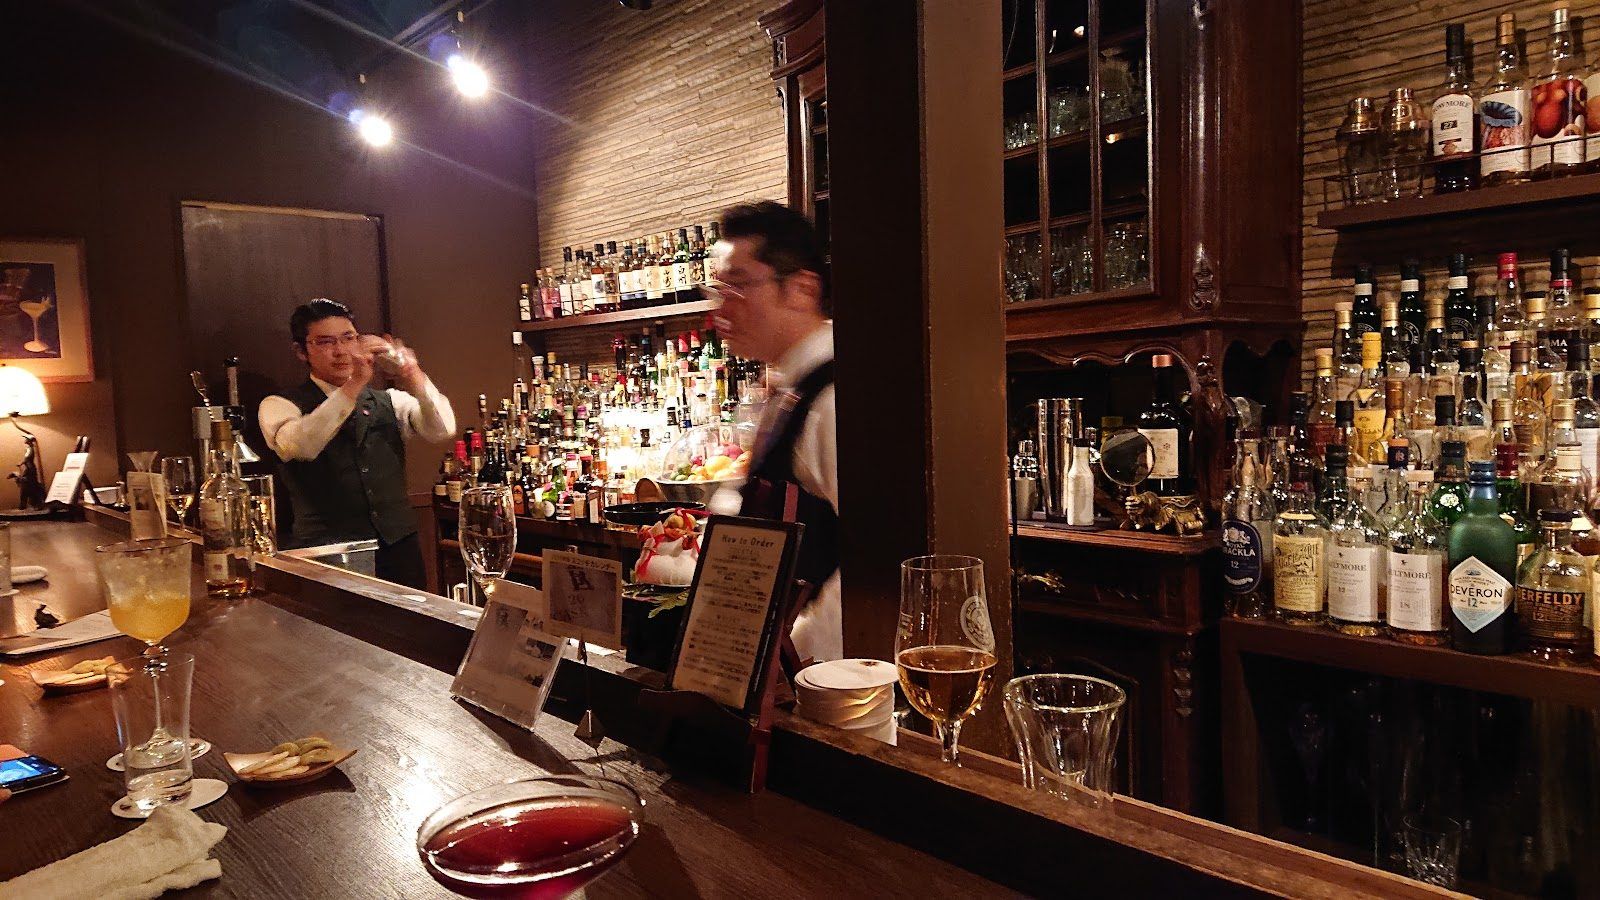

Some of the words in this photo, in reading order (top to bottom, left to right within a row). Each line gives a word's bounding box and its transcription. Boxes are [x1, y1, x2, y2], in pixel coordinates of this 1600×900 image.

[722, 534, 736, 543] How
[740, 537, 748, 545] to
[751, 537, 774, 548] Order
[1231, 560, 1240, 569] 12
[1450, 584, 1503, 598] DEVERON
[1517, 588, 1583, 606] ERFELDY
[1467, 598, 1478, 608] 12
[1532, 611, 1545, 622] 12
